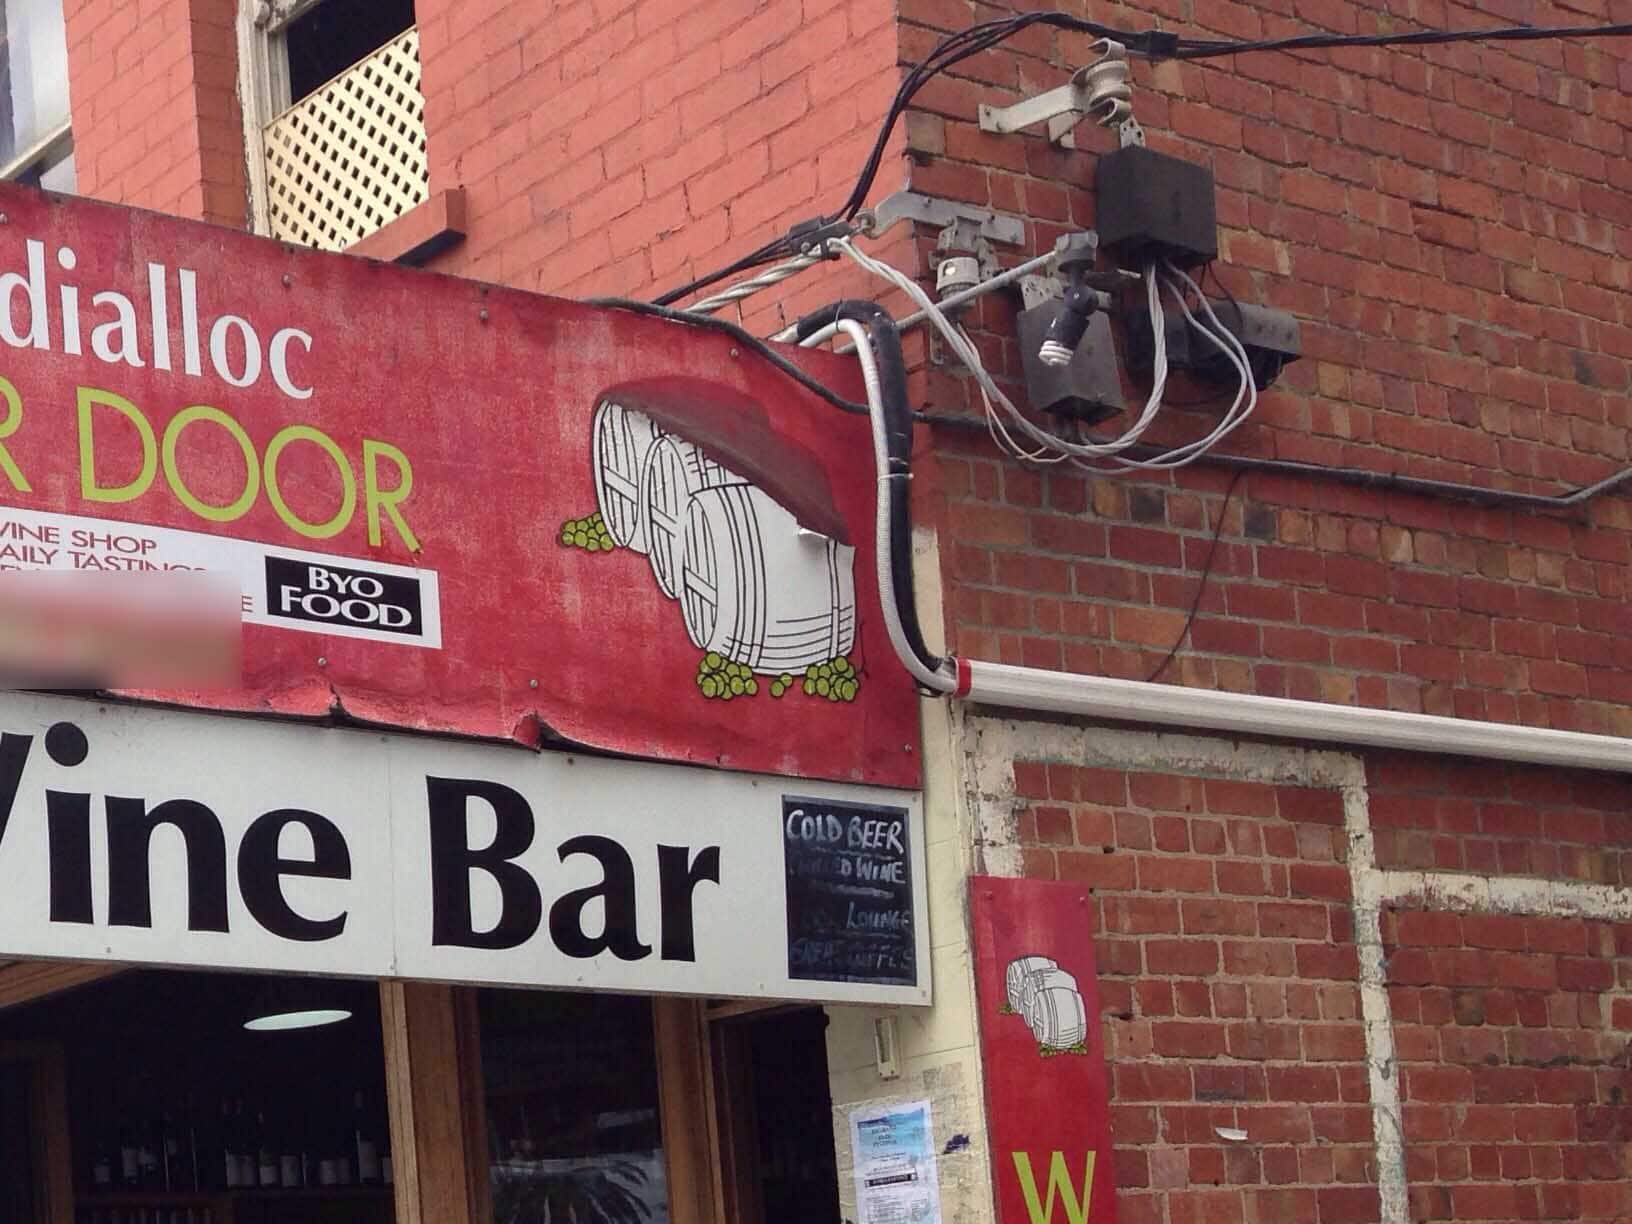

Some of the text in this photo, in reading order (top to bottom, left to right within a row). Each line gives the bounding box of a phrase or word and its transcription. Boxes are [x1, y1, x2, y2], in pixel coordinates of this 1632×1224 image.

[76, 386, 424, 555] DOOR
[71, 530, 158, 554] SHOP
[309, 566, 384, 600] BYO
[280, 585, 412, 628] FOOD
[786, 809, 904, 854] COLD BEER
[426, 775, 721, 963] Bar
